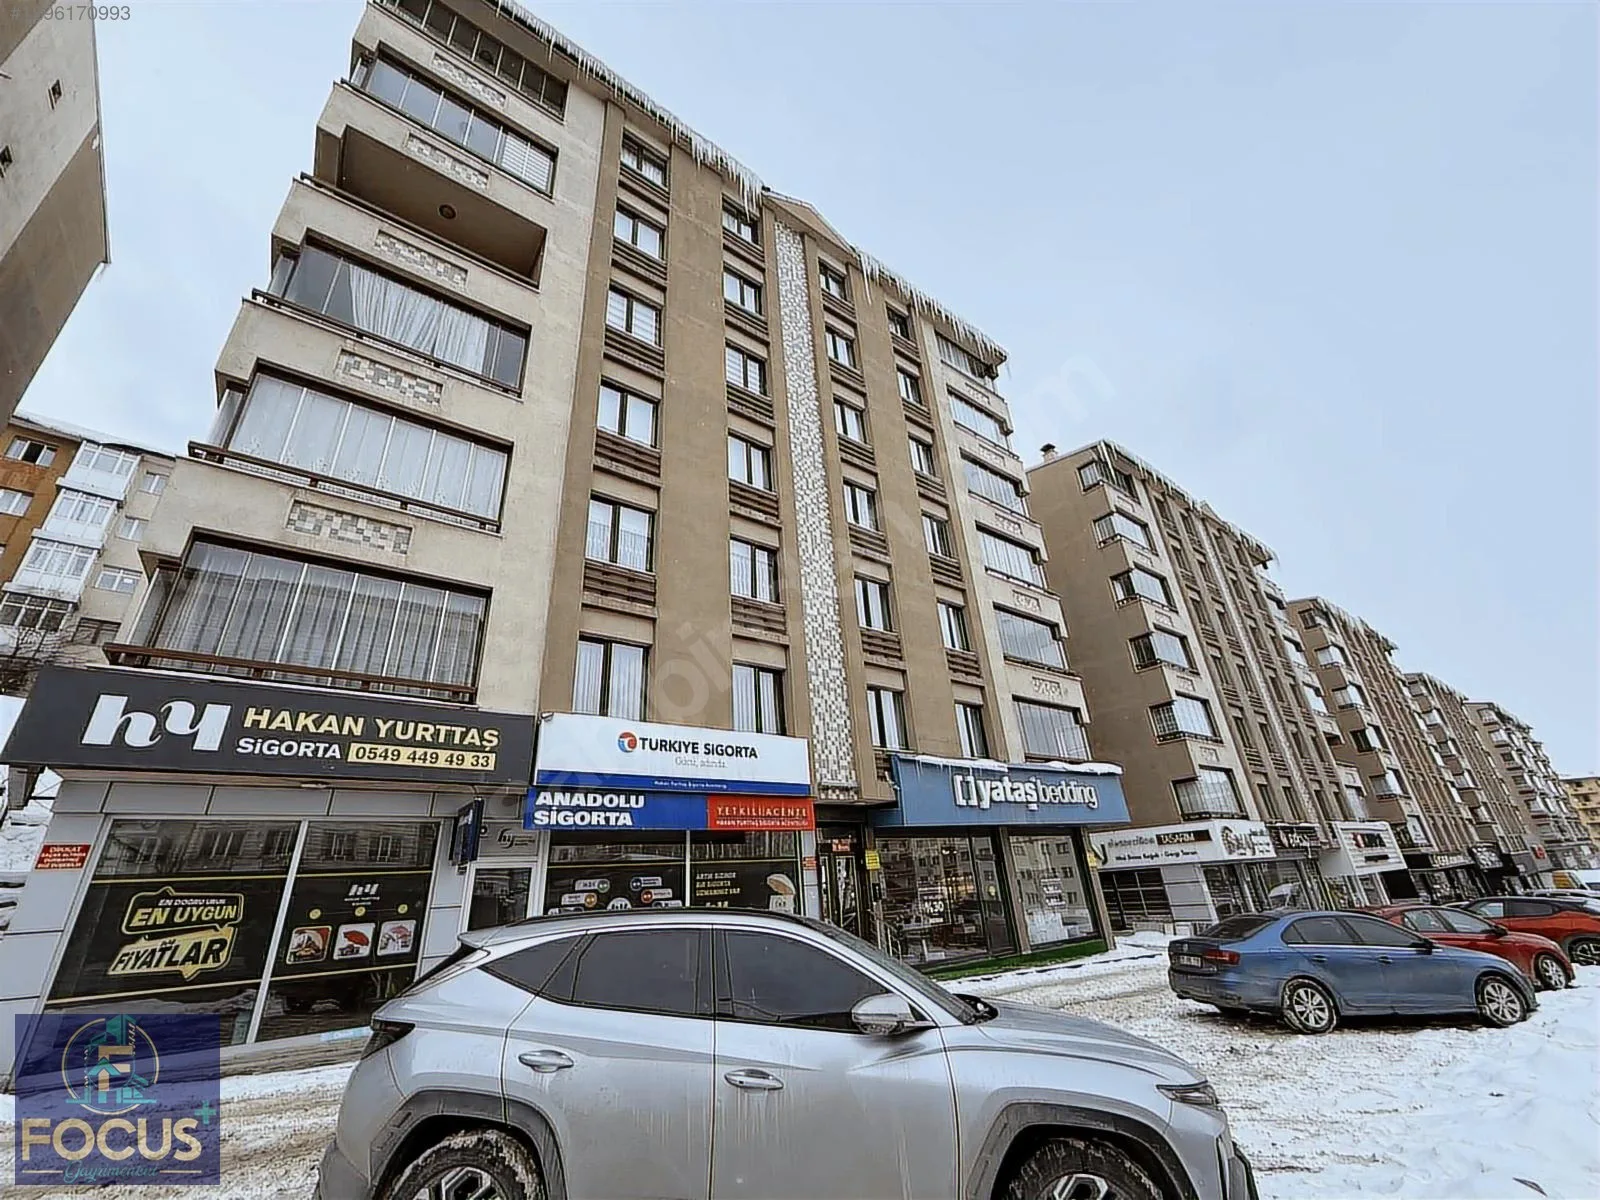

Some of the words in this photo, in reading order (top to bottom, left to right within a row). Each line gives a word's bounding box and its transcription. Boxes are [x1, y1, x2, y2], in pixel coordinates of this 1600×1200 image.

[243, 707, 364, 736] HAKAN
[375, 719, 499, 752] YURTTAŞ
[355, 746, 401, 761] 0549
[407, 750, 439, 764] 449
[445, 753, 466, 766] 49
[471, 755, 490, 767] 33
[535, 791, 645, 808] ANADOLU
[1036, 779, 1099, 809] bedding
[533, 806, 633, 826] SİGORTA
[129, 907, 171, 927] EN
[173, 905, 237, 923] UYGUN
